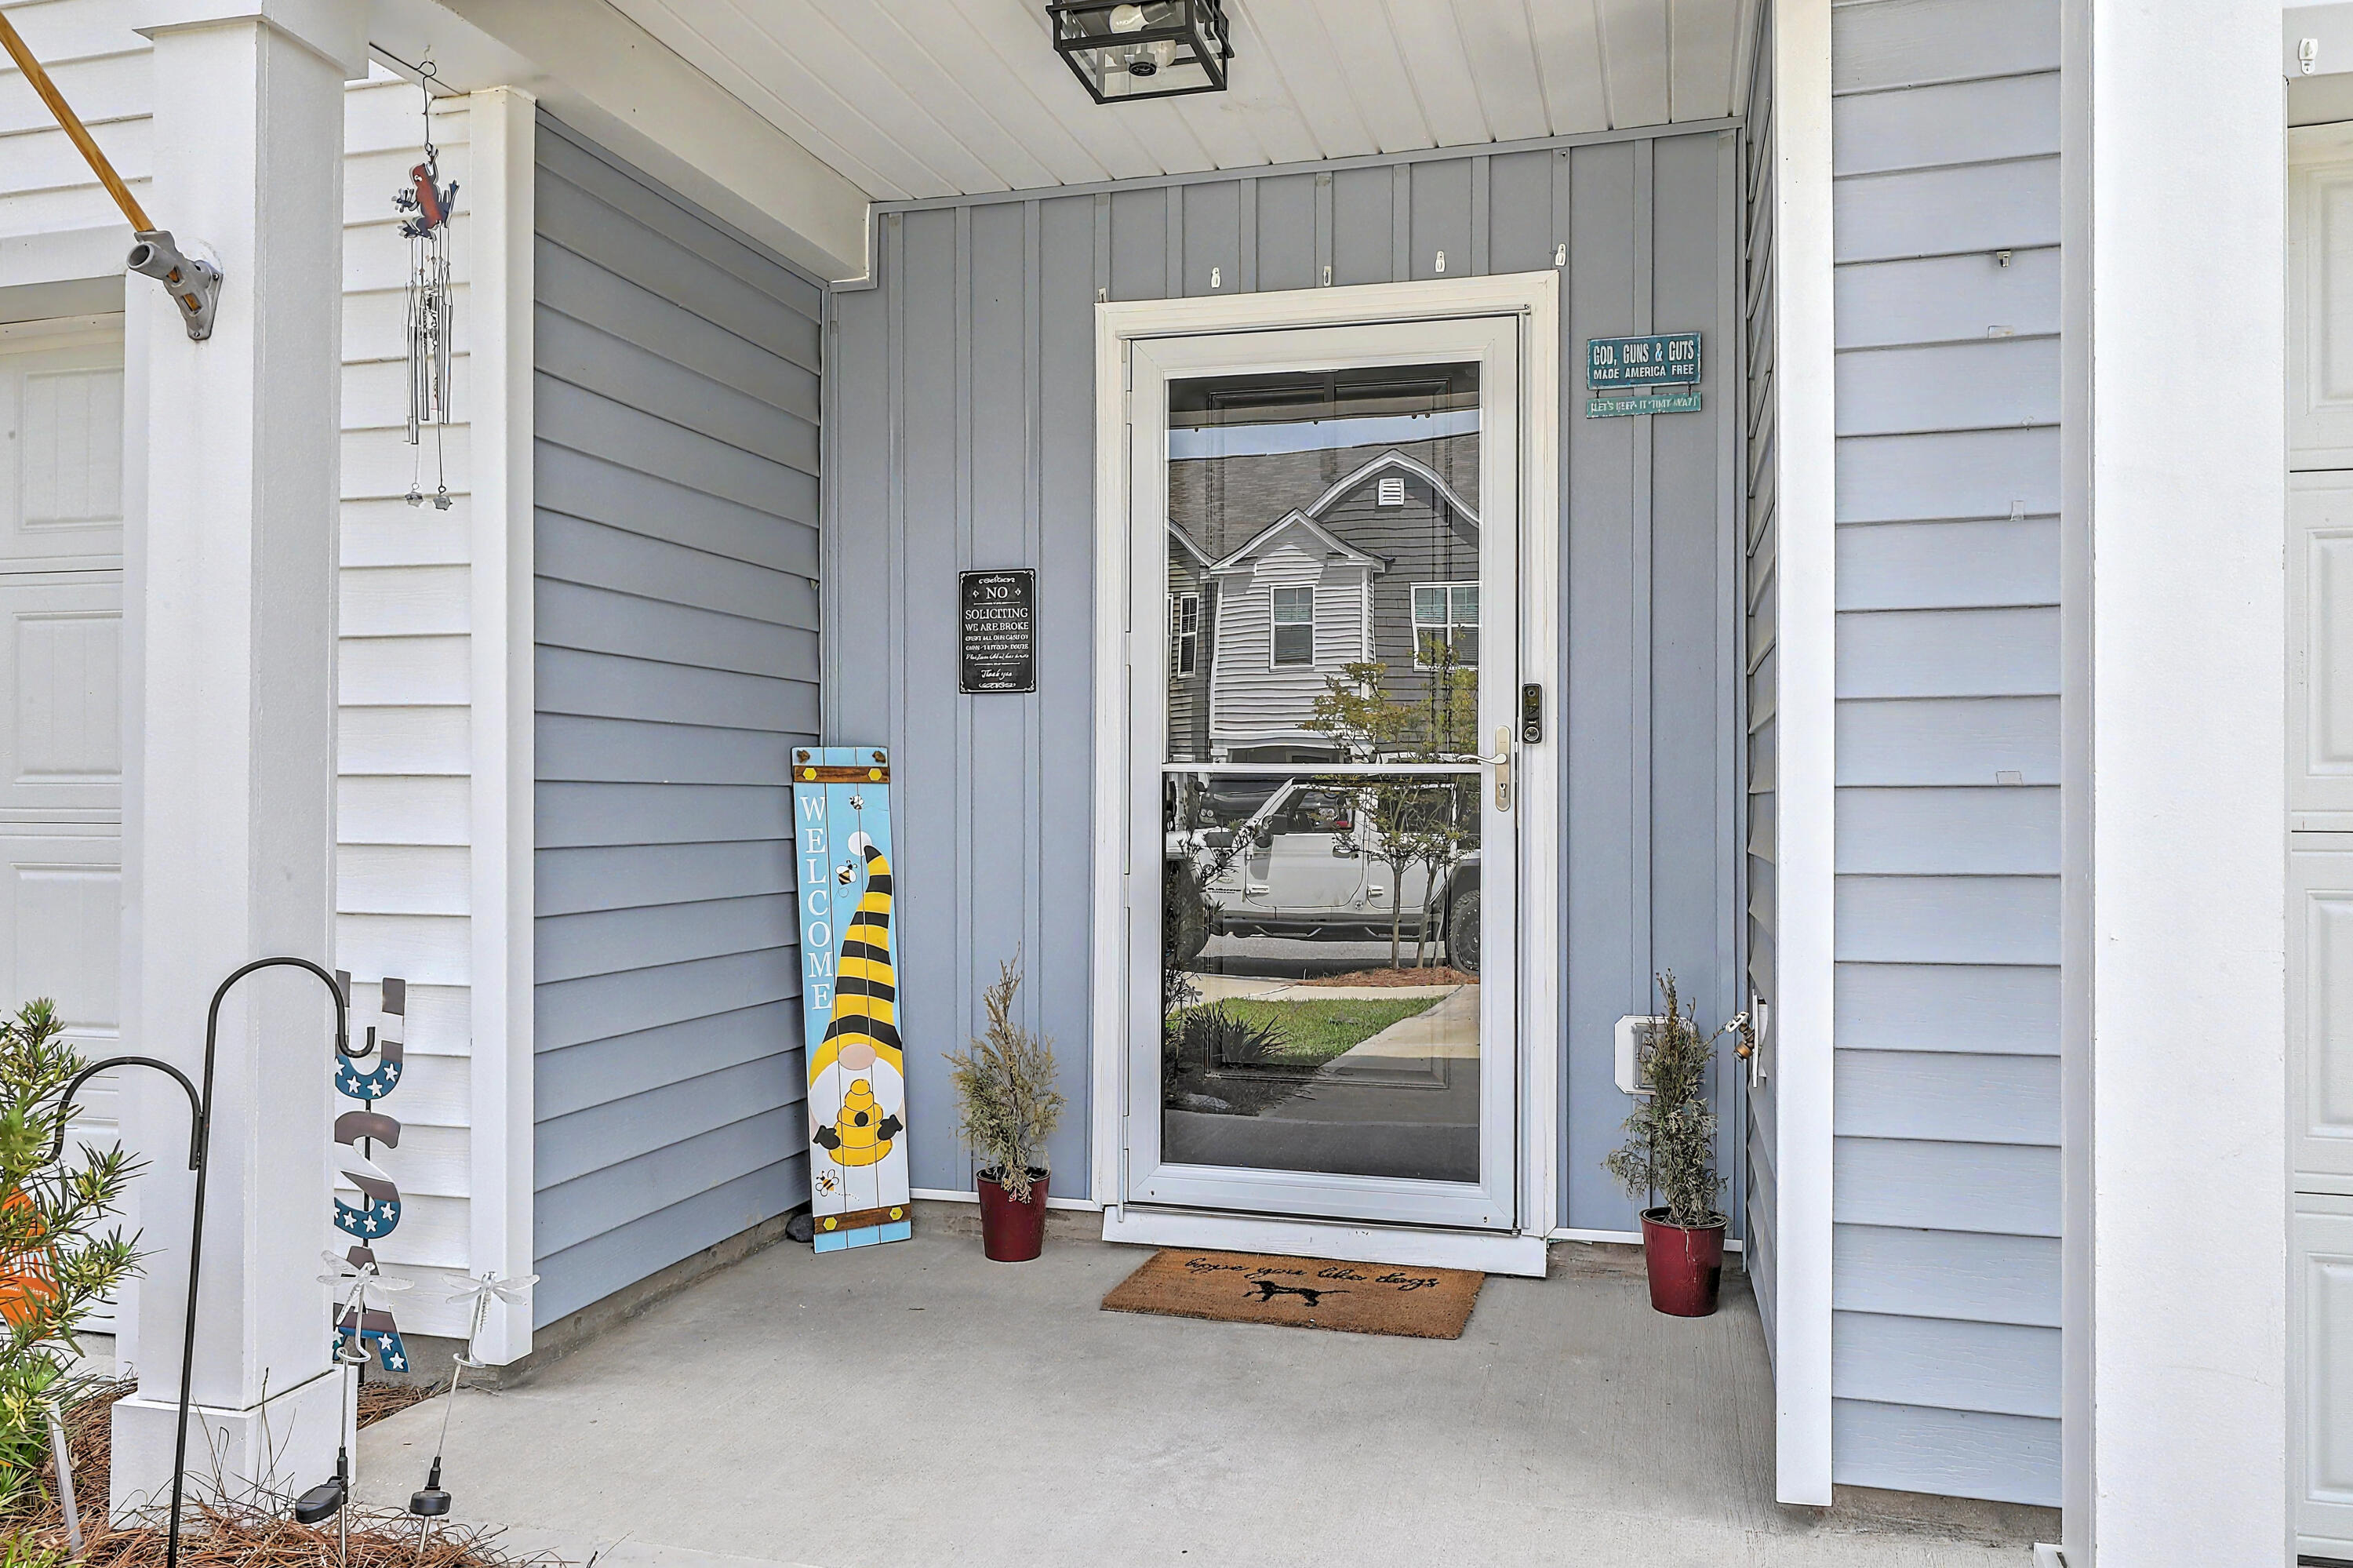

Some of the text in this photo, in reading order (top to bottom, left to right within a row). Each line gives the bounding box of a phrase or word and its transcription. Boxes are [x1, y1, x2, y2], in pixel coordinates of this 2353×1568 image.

[1593, 340, 1694, 366] GOD, GUNS & GUTS
[1593, 363, 1695, 380] MADE AMERICA FREE
[985, 586, 1009, 599] NO
[965, 607, 1028, 620] SOLICITING
[965, 621, 1029, 631] WE ARE BROKE
[799, 796, 834, 1010] WELCOME
[1243, 1267, 1307, 1280] you
[1317, 1267, 1368, 1281] like
[1374, 1272, 1440, 1291] dogs
